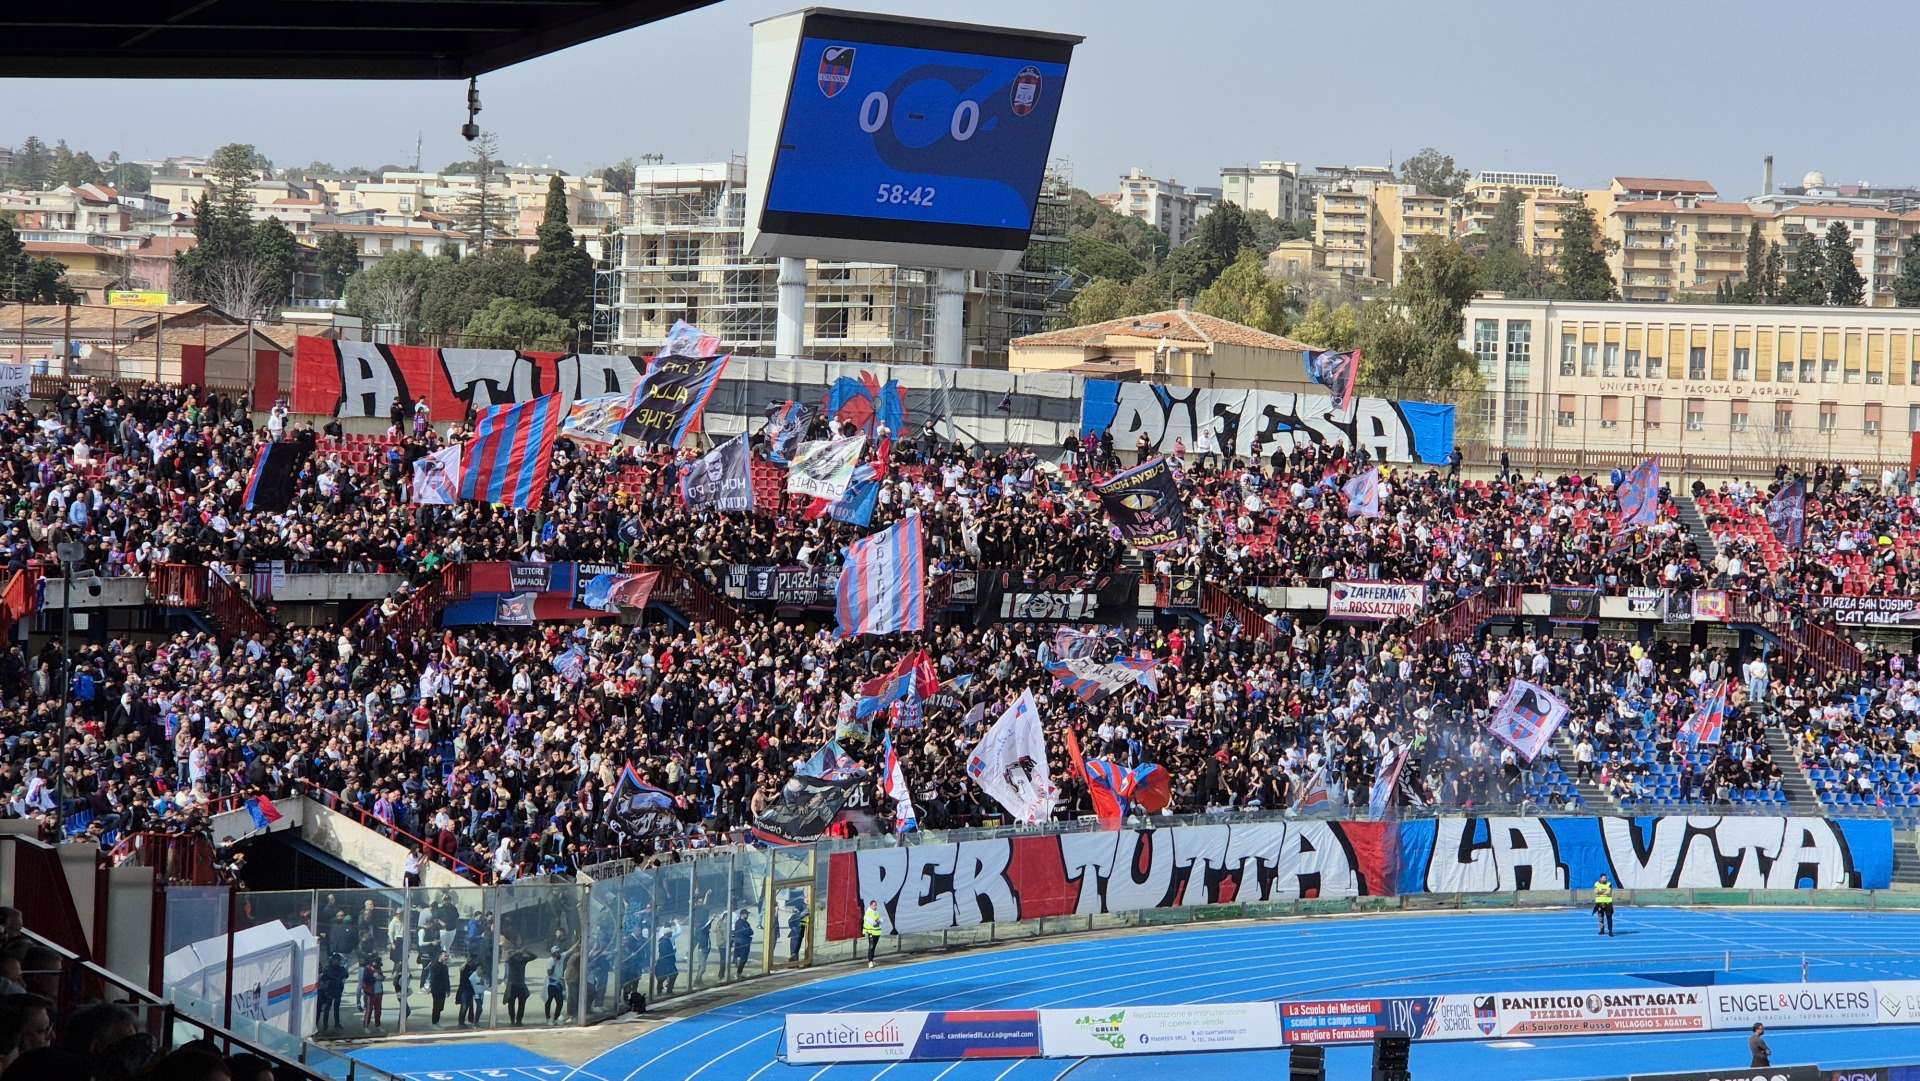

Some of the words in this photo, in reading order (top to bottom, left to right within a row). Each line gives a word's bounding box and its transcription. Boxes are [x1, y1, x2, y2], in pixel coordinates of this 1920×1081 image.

[858, 91, 889, 133] 0
[950, 99, 980, 141] 0
[876, 183, 936, 206] 58:42
[335, 340, 412, 418] A
[1751, 387, 1801, 396] AGRARIA
[516, 567, 545, 576] SETTORE
[579, 563, 617, 575] CATANIA
[513, 577, 527, 586] SAN
[1027, 573, 1111, 591] AZZI
[1350, 586, 1407, 602] ZAFFERANA
[1347, 601, 1412, 616] ROSSAZZURR
[1822, 596, 1857, 610] PIAZZA
[1858, 598, 1878, 610] SAN
[1878, 598, 1914, 611] COSIMO
[1835, 609, 1900, 624] CATANIA
[853, 836, 1021, 937] PER
[1058, 820, 1368, 915] TUTTA
[1424, 817, 1571, 893] LA
[1289, 1004, 1299, 1016] La
[1300, 1004, 1324, 1016] Scuola
[1325, 1003, 1339, 1015] dei
[1339, 1002, 1372, 1014] Mestieri
[1501, 996, 1584, 1010] PANIFICIO
[1603, 993, 1697, 1008] SANT'AGATA
[1133, 1011, 1186, 1020] Realizzazione
[1194, 1009, 1247, 1018] manutenzione
[1441, 1003, 1472, 1018] OFFICIAL
[1530, 1009, 1584, 1020] PIZZERIA
[1606, 1007, 1677, 1018] PASTICCERIA
[1159, 1020, 1167, 1028] di
[1290, 1016, 1318, 1028] scende
[1318, 1016, 1327, 1027] in
[1326, 1016, 1352, 1028] campo
[1352, 1016, 1367, 1026] con
[1443, 1017, 1472, 1032] SCHOOL
[1518, 1022, 1529, 1032] di
[1531, 1021, 1580, 1032] Salvatore
[1583, 1021, 1611, 1031] Russo
[1614, 1018, 1654, 1029] VILLAGGIO
[1655, 1018, 1663, 1028] S.
[1664, 1017, 1688, 1027] AGATA
[1693, 1016, 1703, 1027] CT
[797, 1024, 860, 1047] cantieri
[863, 1024, 901, 1044] edili
[1291, 1030, 1300, 1042] la
[1300, 1029, 1331, 1043] migliore
[1332, 1028, 1375, 1040] Formazione
